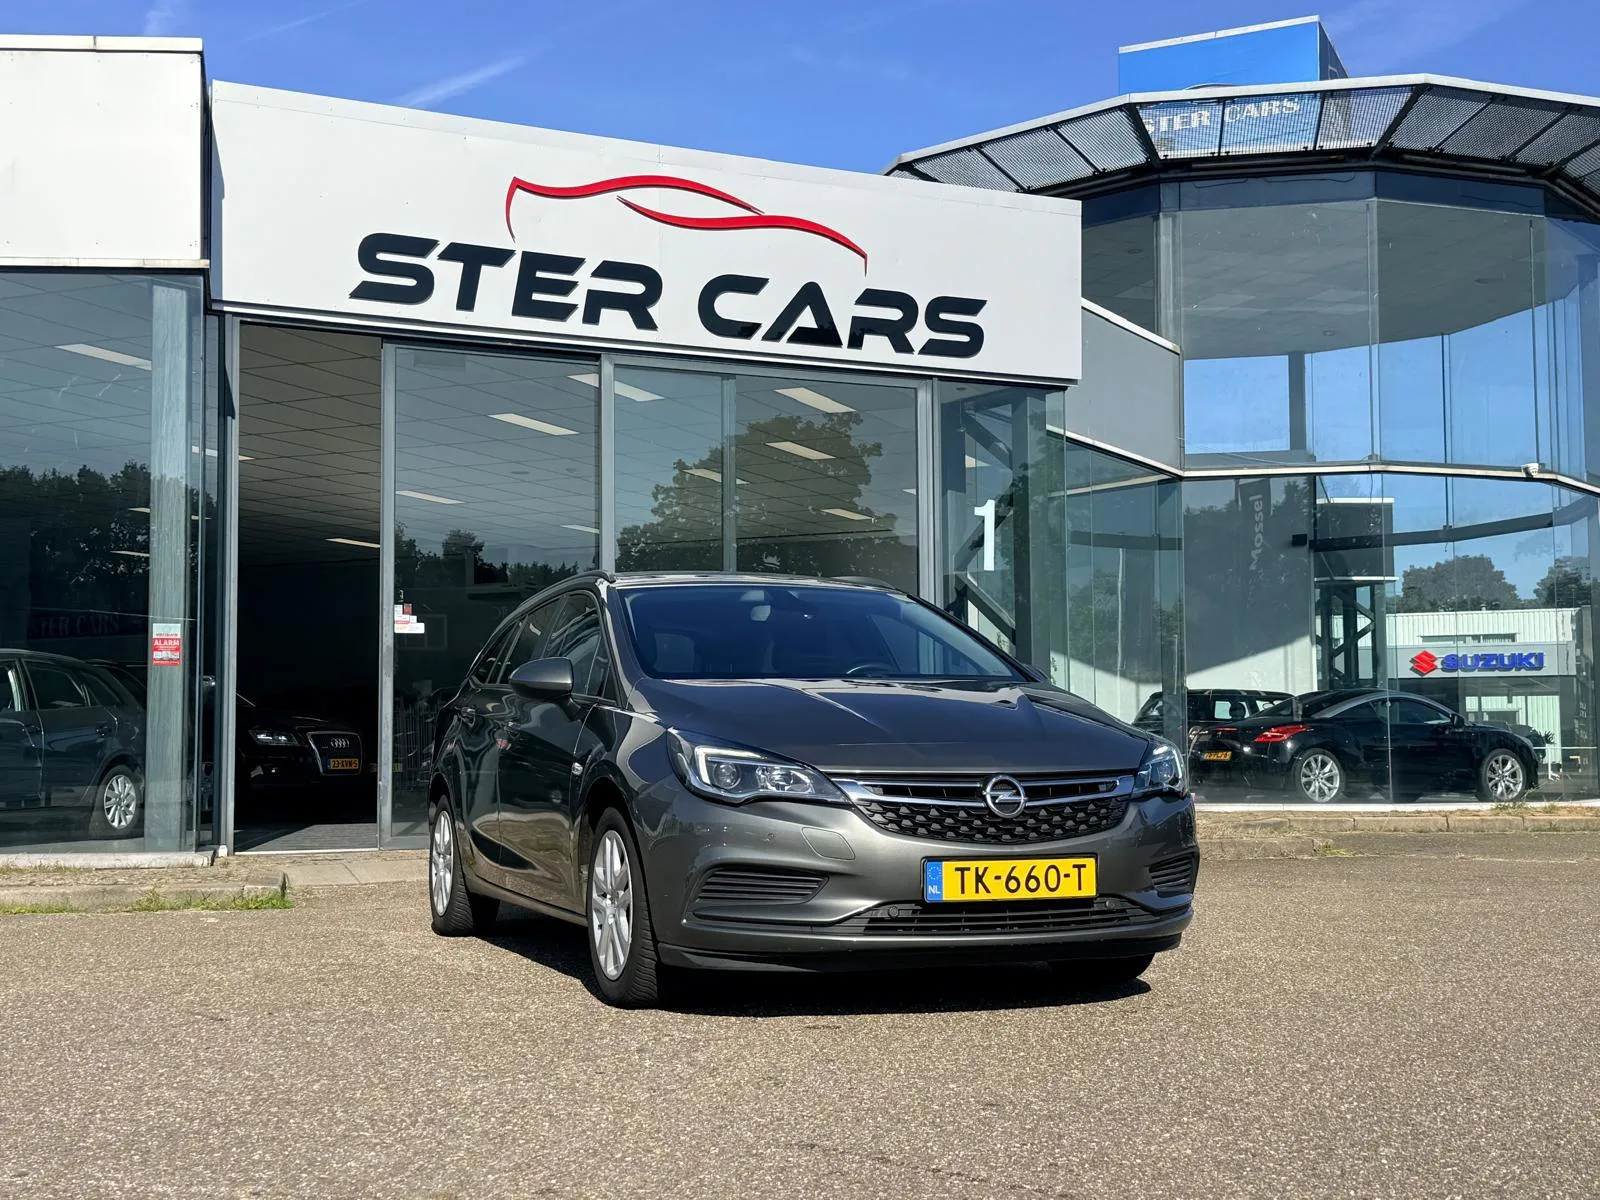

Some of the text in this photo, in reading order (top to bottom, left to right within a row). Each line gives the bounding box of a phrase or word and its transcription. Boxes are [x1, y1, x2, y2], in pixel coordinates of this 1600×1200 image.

[1224, 98, 1301, 122] CARS
[350, 232, 988, 358] STER CARS
[974, 499, 996, 571] 1
[1248, 493, 1264, 571] Mossel
[1440, 652, 1545, 672] SUZUKI
[928, 863, 1087, 895] NL TK-660-T
